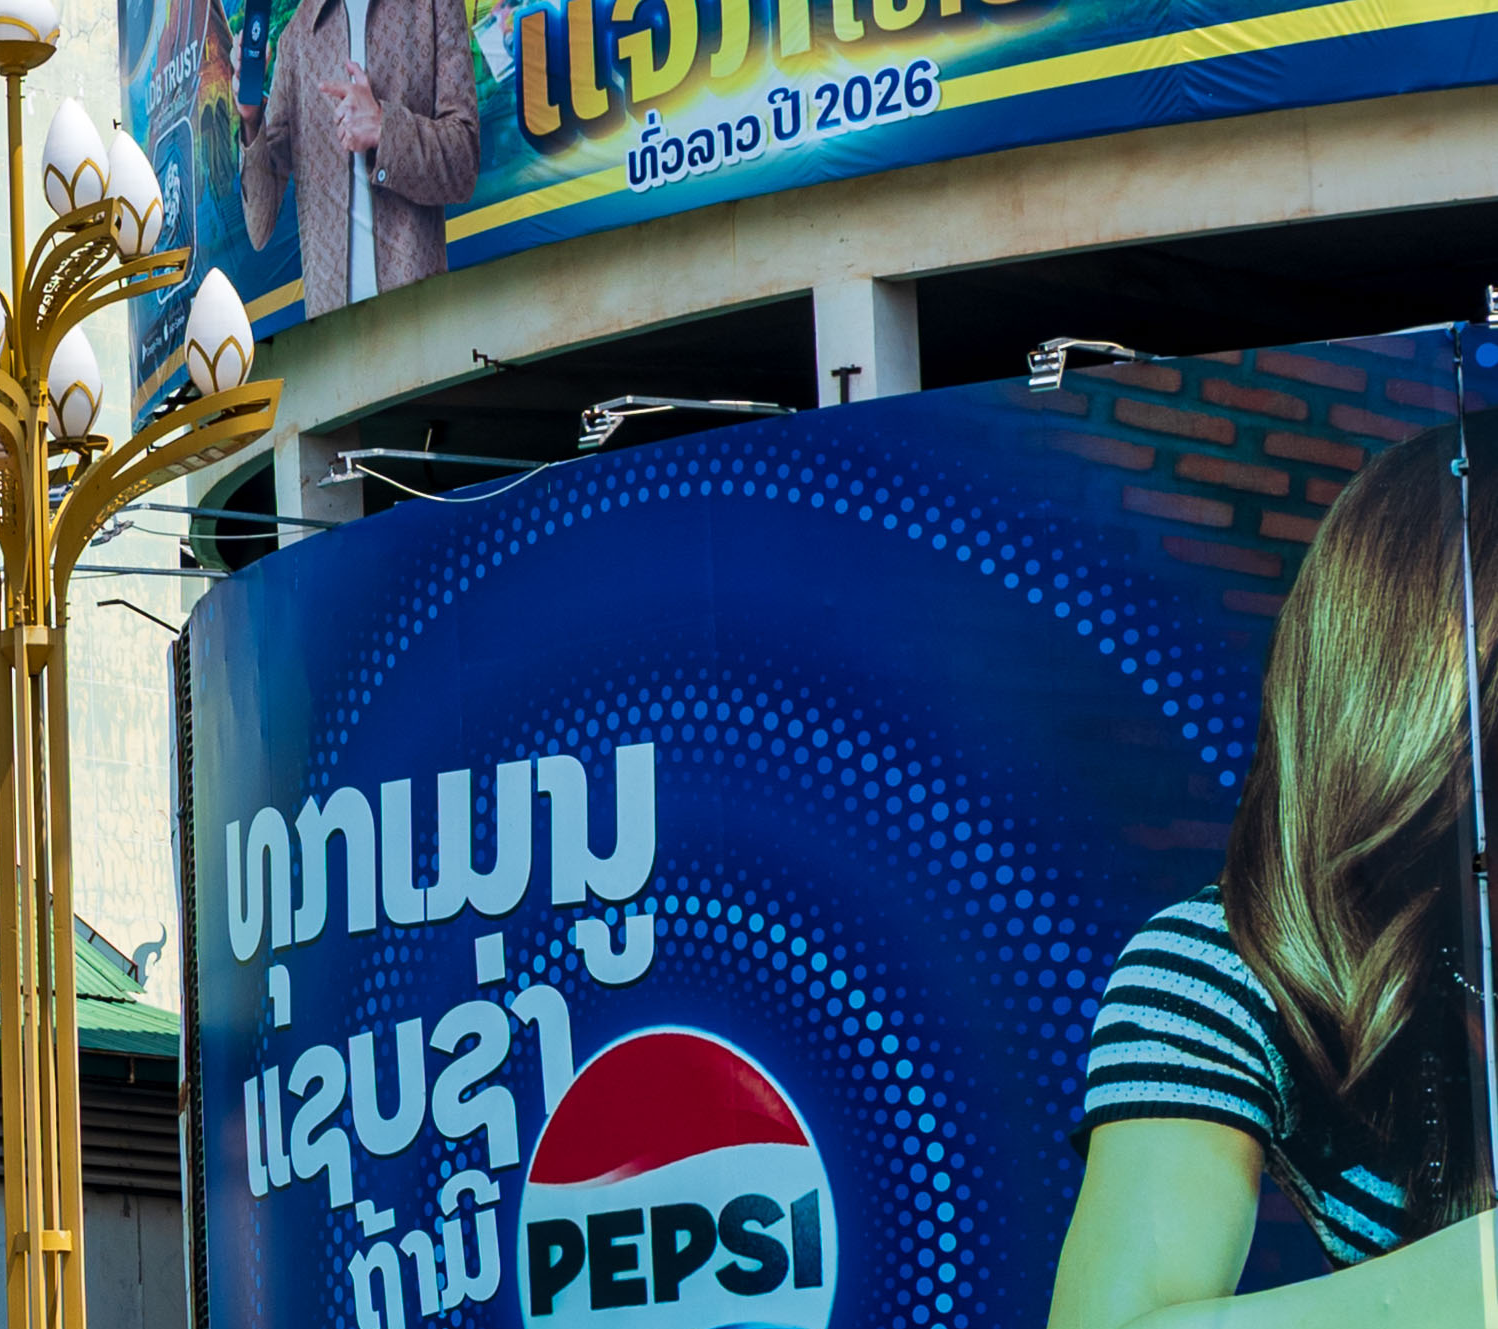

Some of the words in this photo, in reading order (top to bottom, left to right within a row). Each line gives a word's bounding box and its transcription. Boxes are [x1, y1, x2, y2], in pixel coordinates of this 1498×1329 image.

[145, 74, 163, 117] LDB
[162, 39, 199, 96] TRUST
[627, 110, 762, 187] ທົ່ວລາວ
[814, 59, 935, 130] 2026
[527, 1187, 824, 1318] PEPSI
